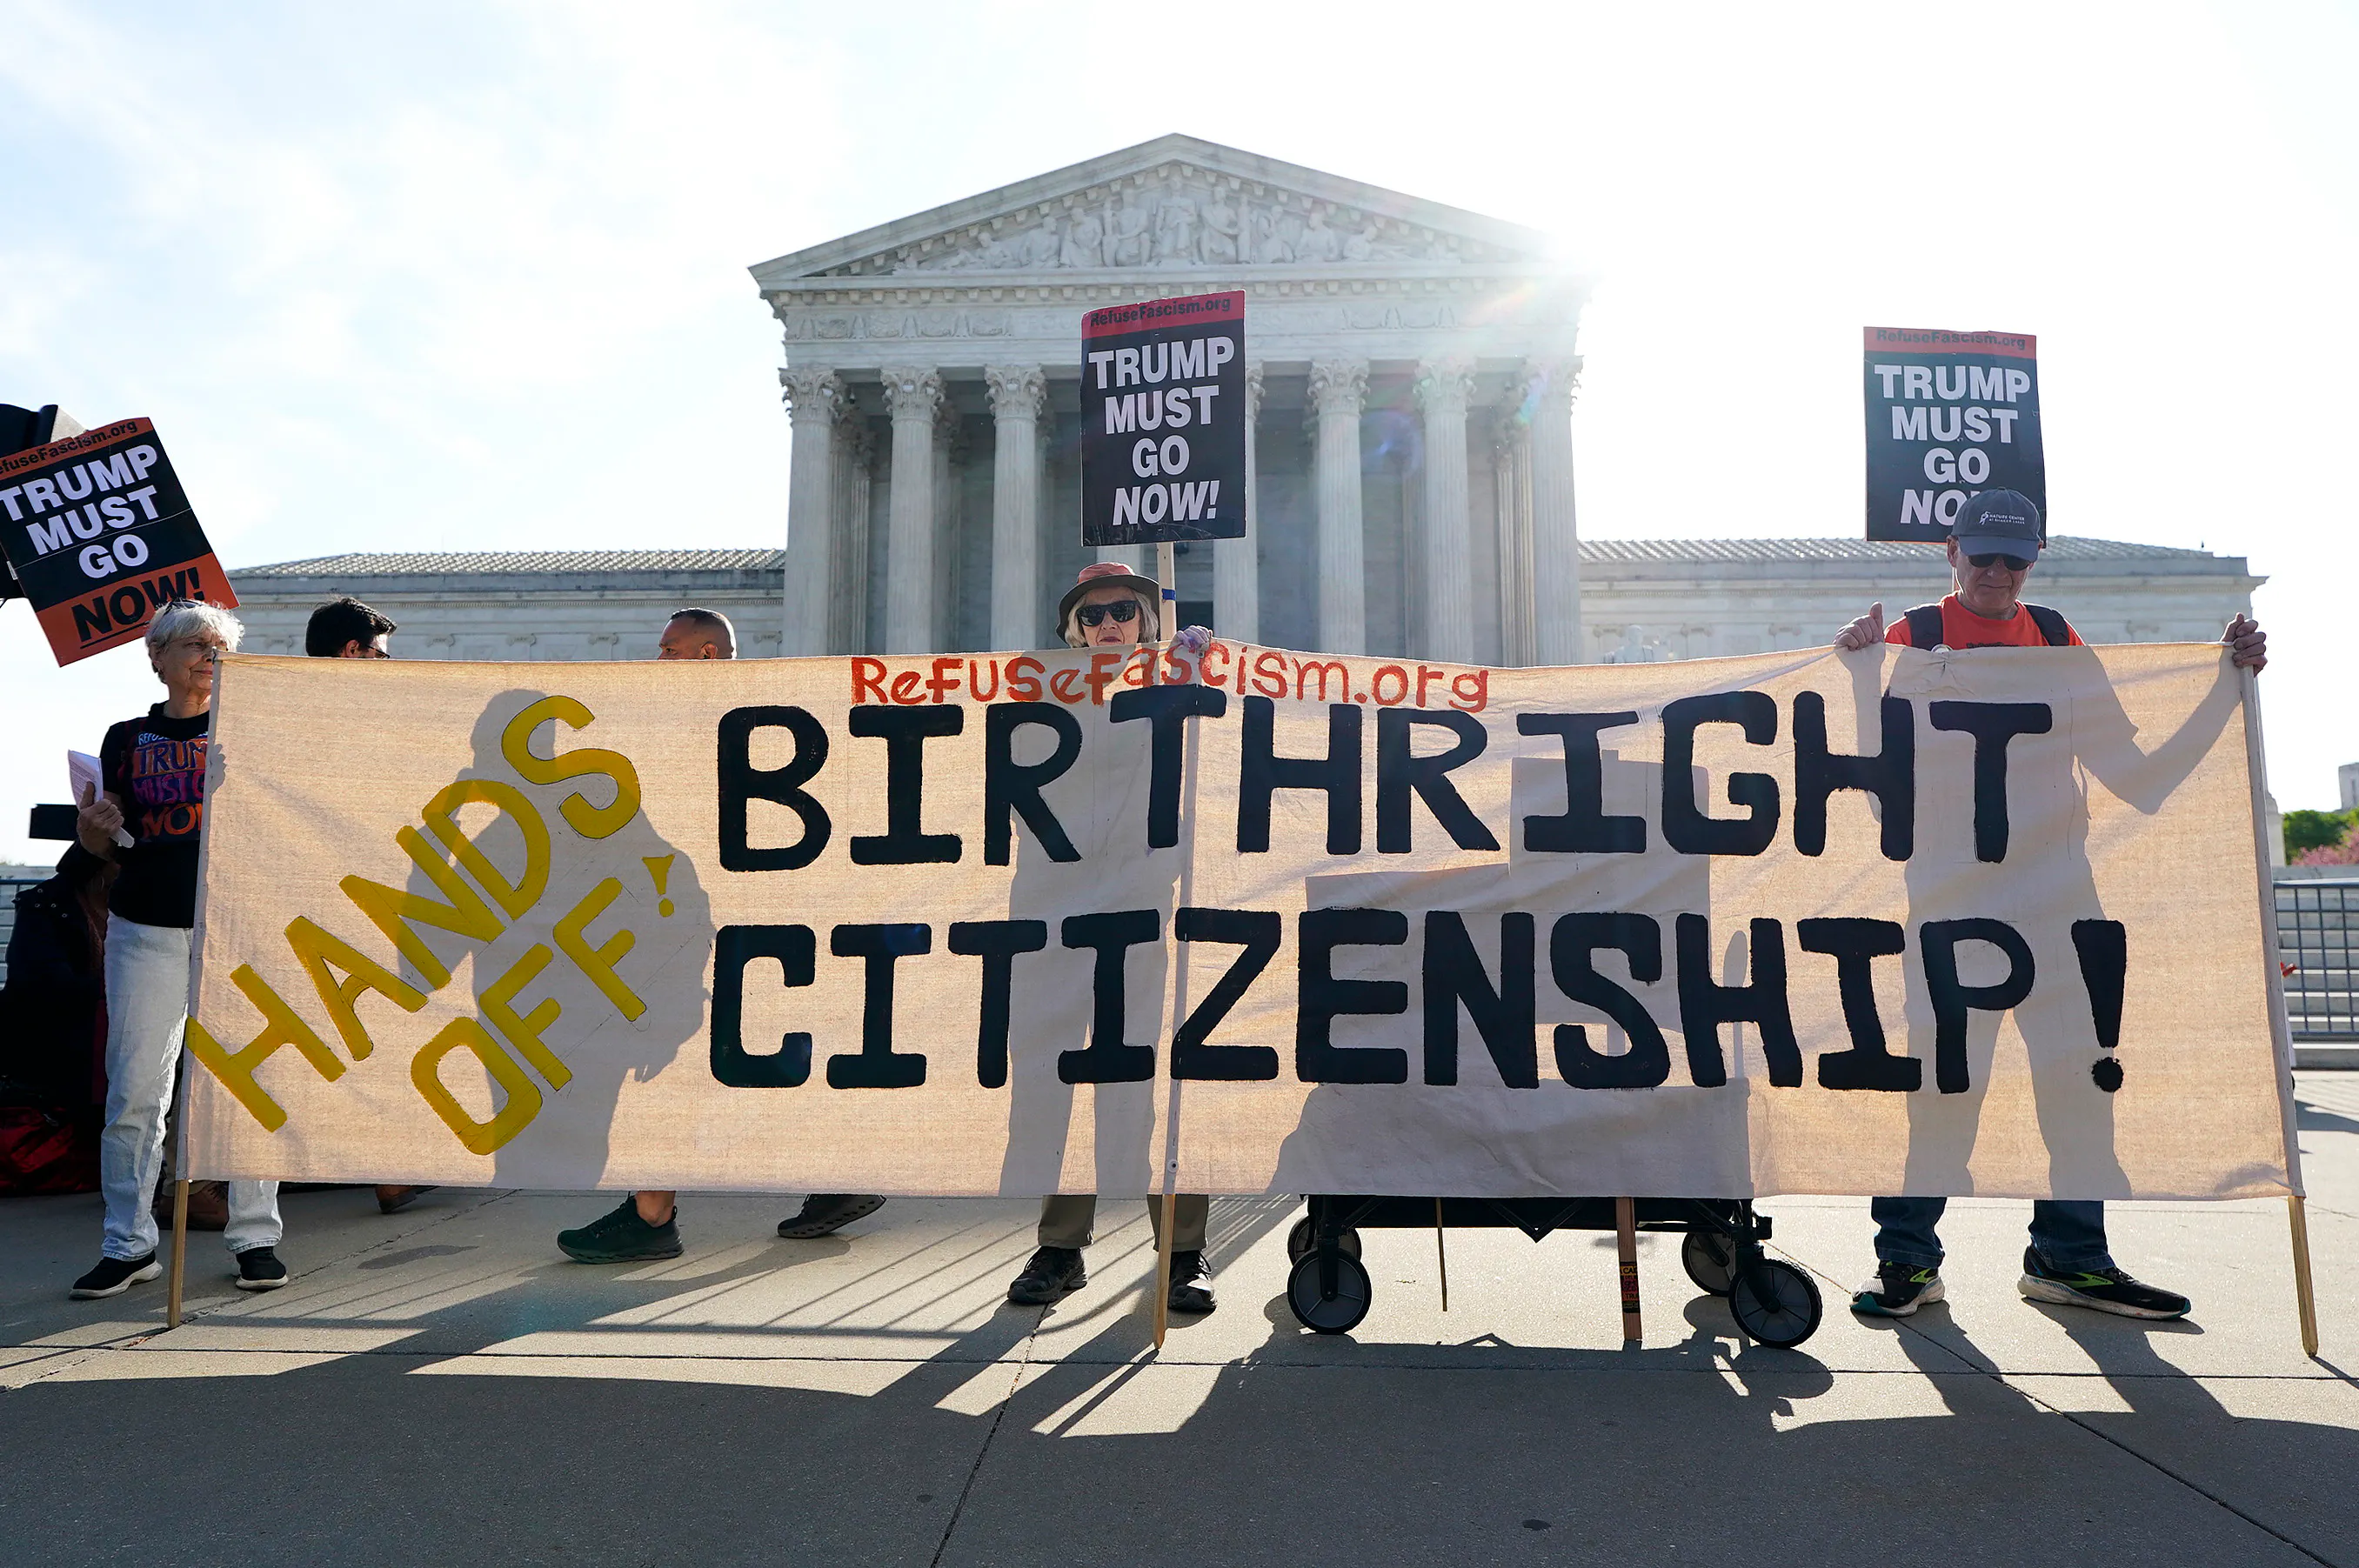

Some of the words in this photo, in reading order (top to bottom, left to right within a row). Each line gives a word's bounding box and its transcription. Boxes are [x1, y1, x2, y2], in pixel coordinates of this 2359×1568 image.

[1091, 297, 1231, 327] RefuseFascism.org
[1876, 329, 2026, 350] RefuseFascism.org
[1088, 337, 1235, 390] TRUMP
[1875, 364, 2031, 403] TRUMP
[1105, 385, 1220, 435] MUST
[1892, 406, 2018, 444] MUST
[0, 421, 137, 475] efuseFascism.org
[1133, 435, 1190, 478] GO
[1923, 447, 1990, 484] GO
[0, 444, 157, 521] TRUMP
[1113, 480, 1220, 526] NOW!
[26, 484, 159, 556] MUST
[78, 534, 149, 579] GO
[70, 567, 205, 643] NOW!
[135, 740, 208, 774] TRUM
[717, 684, 2053, 872] BIRTHRIGHT
[132, 771, 188, 804] MUST
[141, 803, 204, 837] NO
[185, 695, 641, 1132] HANDS
[410, 853, 676, 1156] OFF!
[709, 907, 2127, 1096] CITIZENSHIP!
